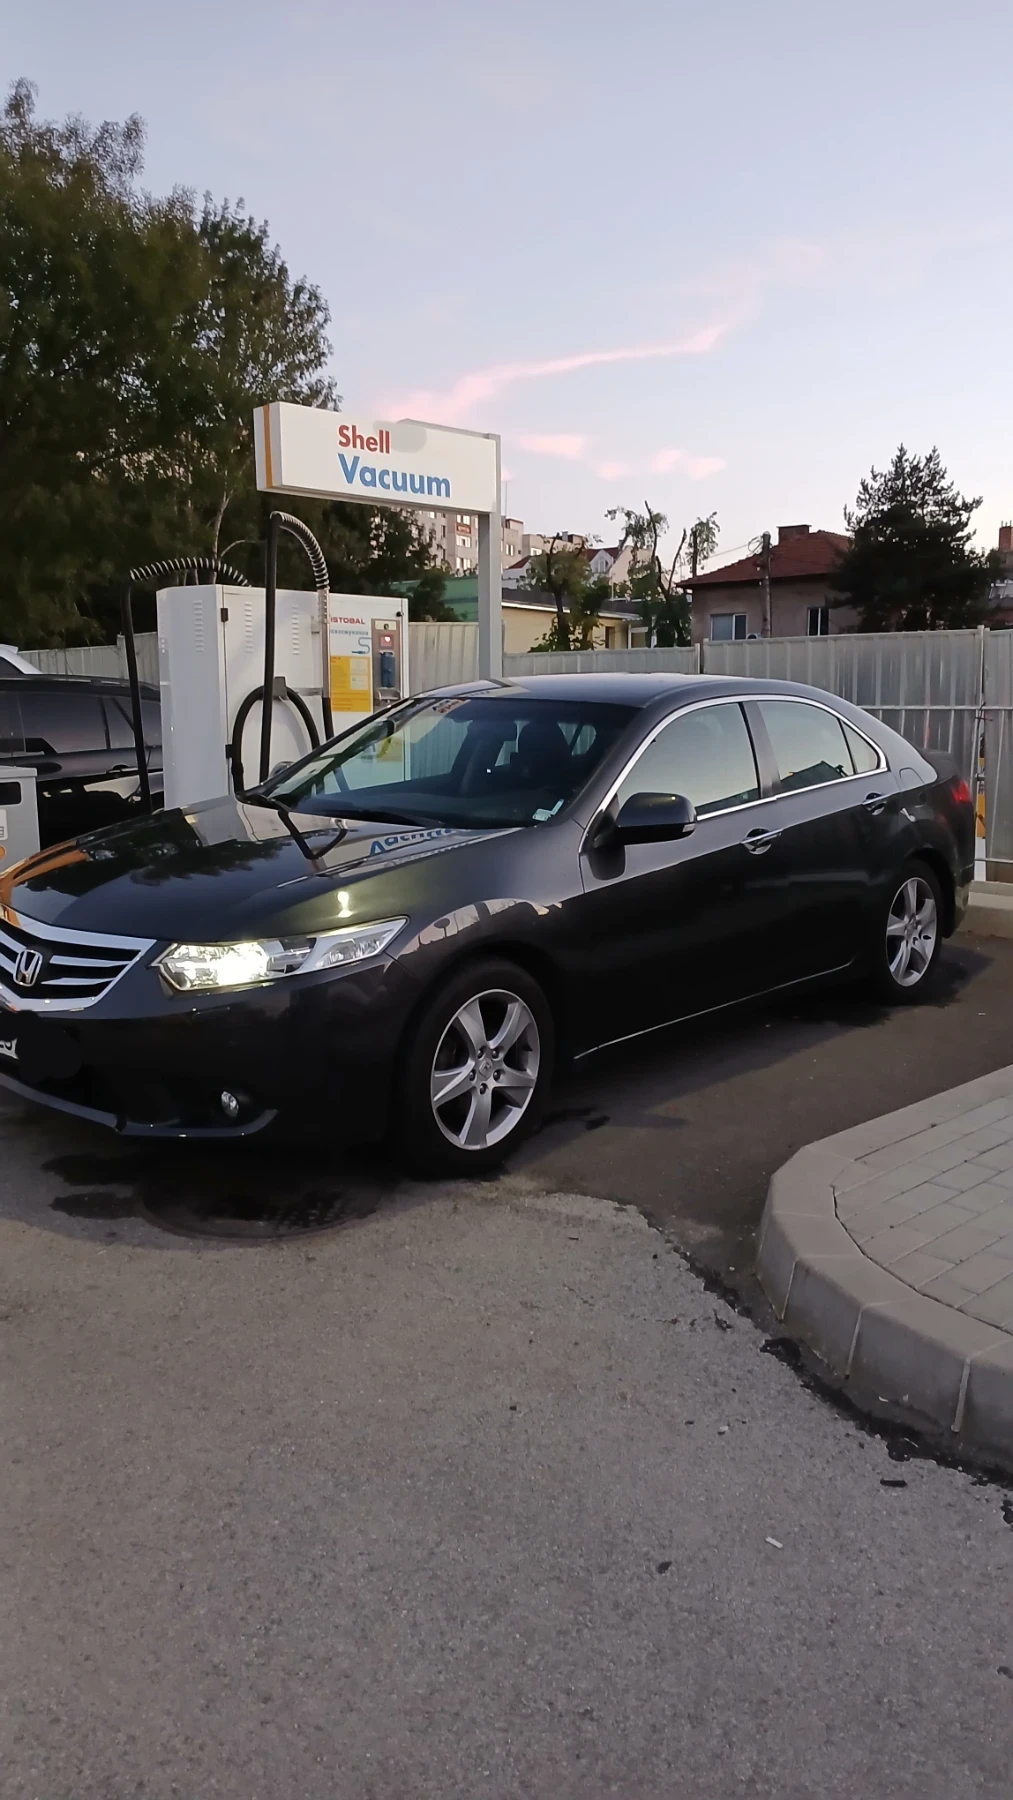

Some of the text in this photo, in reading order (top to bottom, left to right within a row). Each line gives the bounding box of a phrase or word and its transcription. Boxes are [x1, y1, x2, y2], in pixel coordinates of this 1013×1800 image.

[338, 424, 390, 454] Shell
[337, 452, 451, 498] Vacuum
[330, 616, 366, 625] ISTOBAL
